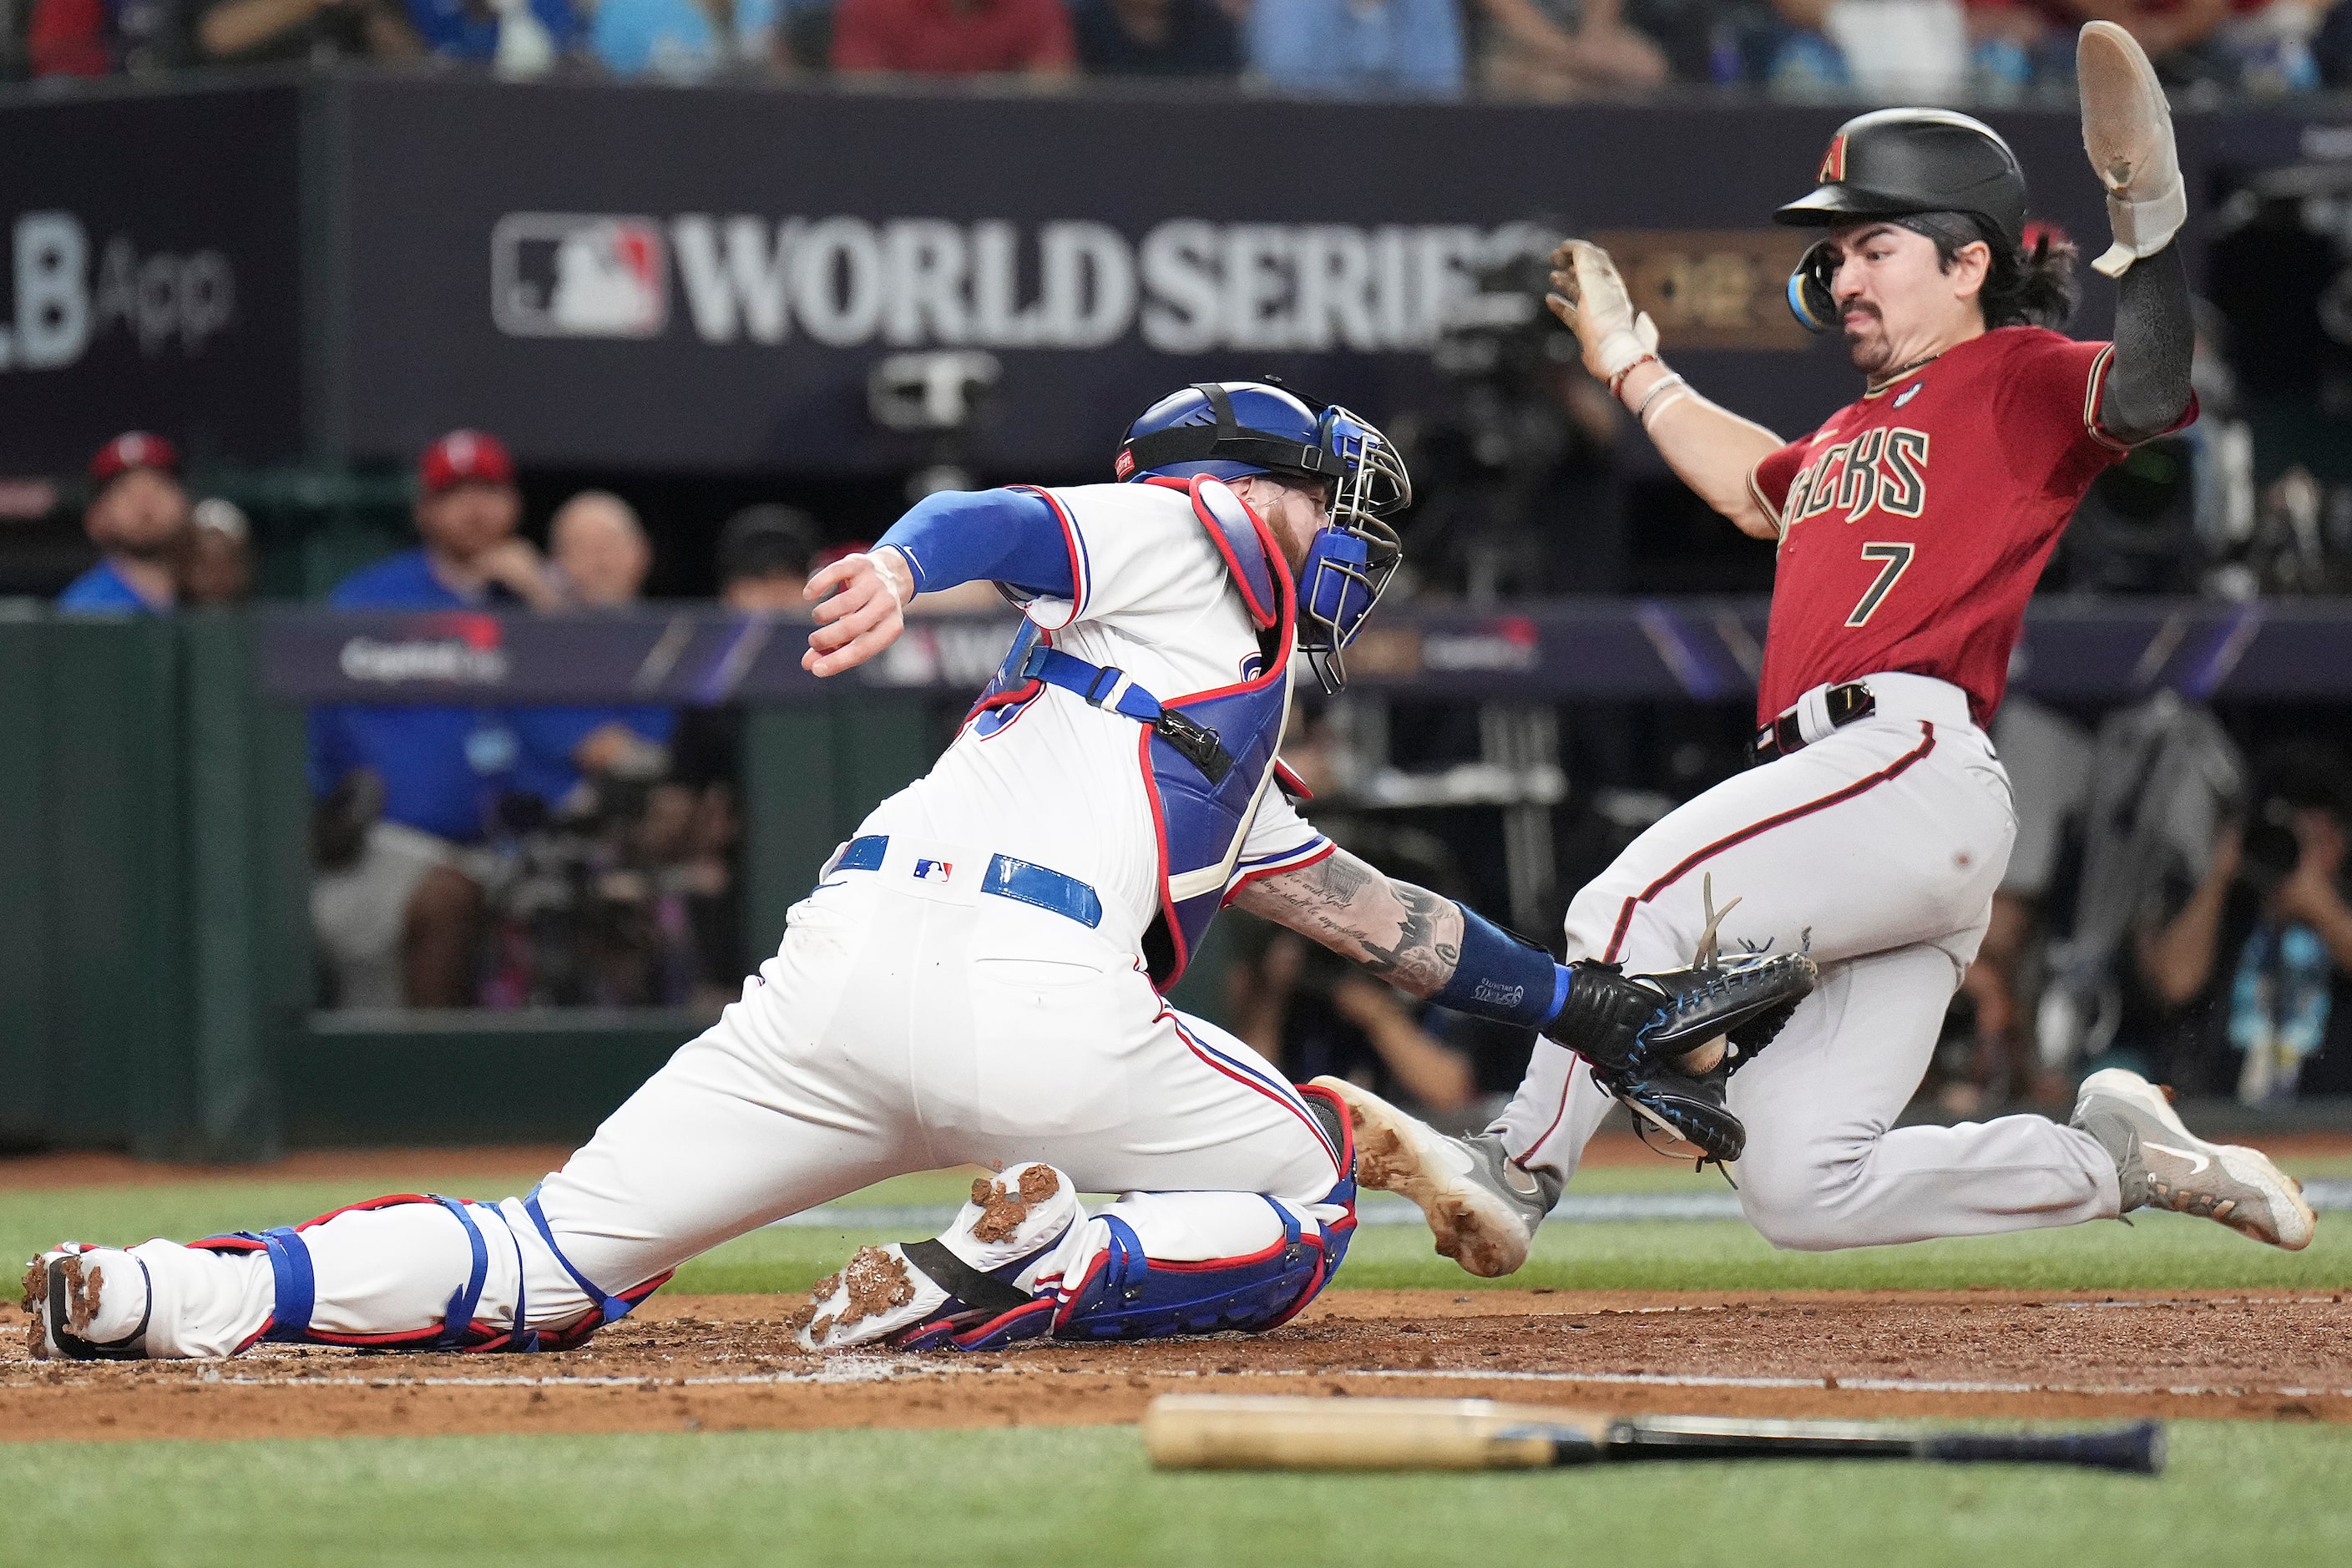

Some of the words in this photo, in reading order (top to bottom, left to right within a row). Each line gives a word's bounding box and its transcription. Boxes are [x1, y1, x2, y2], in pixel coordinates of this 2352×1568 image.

[1817, 134, 1849, 183] A
[92, 234, 235, 359] App
[672, 213, 1136, 346] WORLD
[1844, 541, 1915, 628] 7
